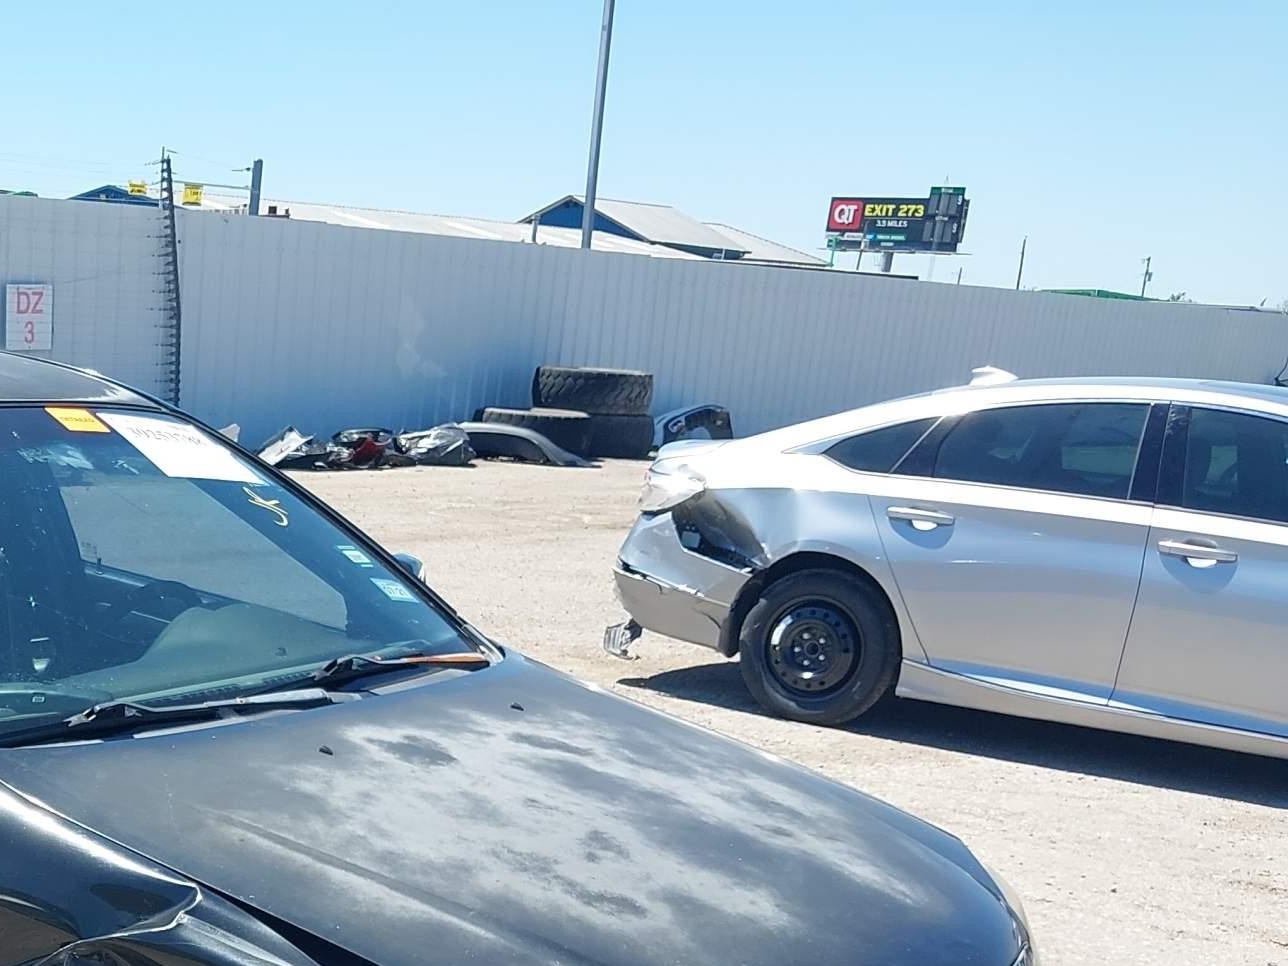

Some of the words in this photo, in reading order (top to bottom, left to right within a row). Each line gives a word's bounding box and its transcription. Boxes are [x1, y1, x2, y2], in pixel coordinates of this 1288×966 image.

[833, 203, 859, 225] QT
[864, 204, 896, 217] EXIT
[897, 204, 925, 217] 273
[16, 290, 44, 314] DZ
[24, 321, 35, 344] 3
